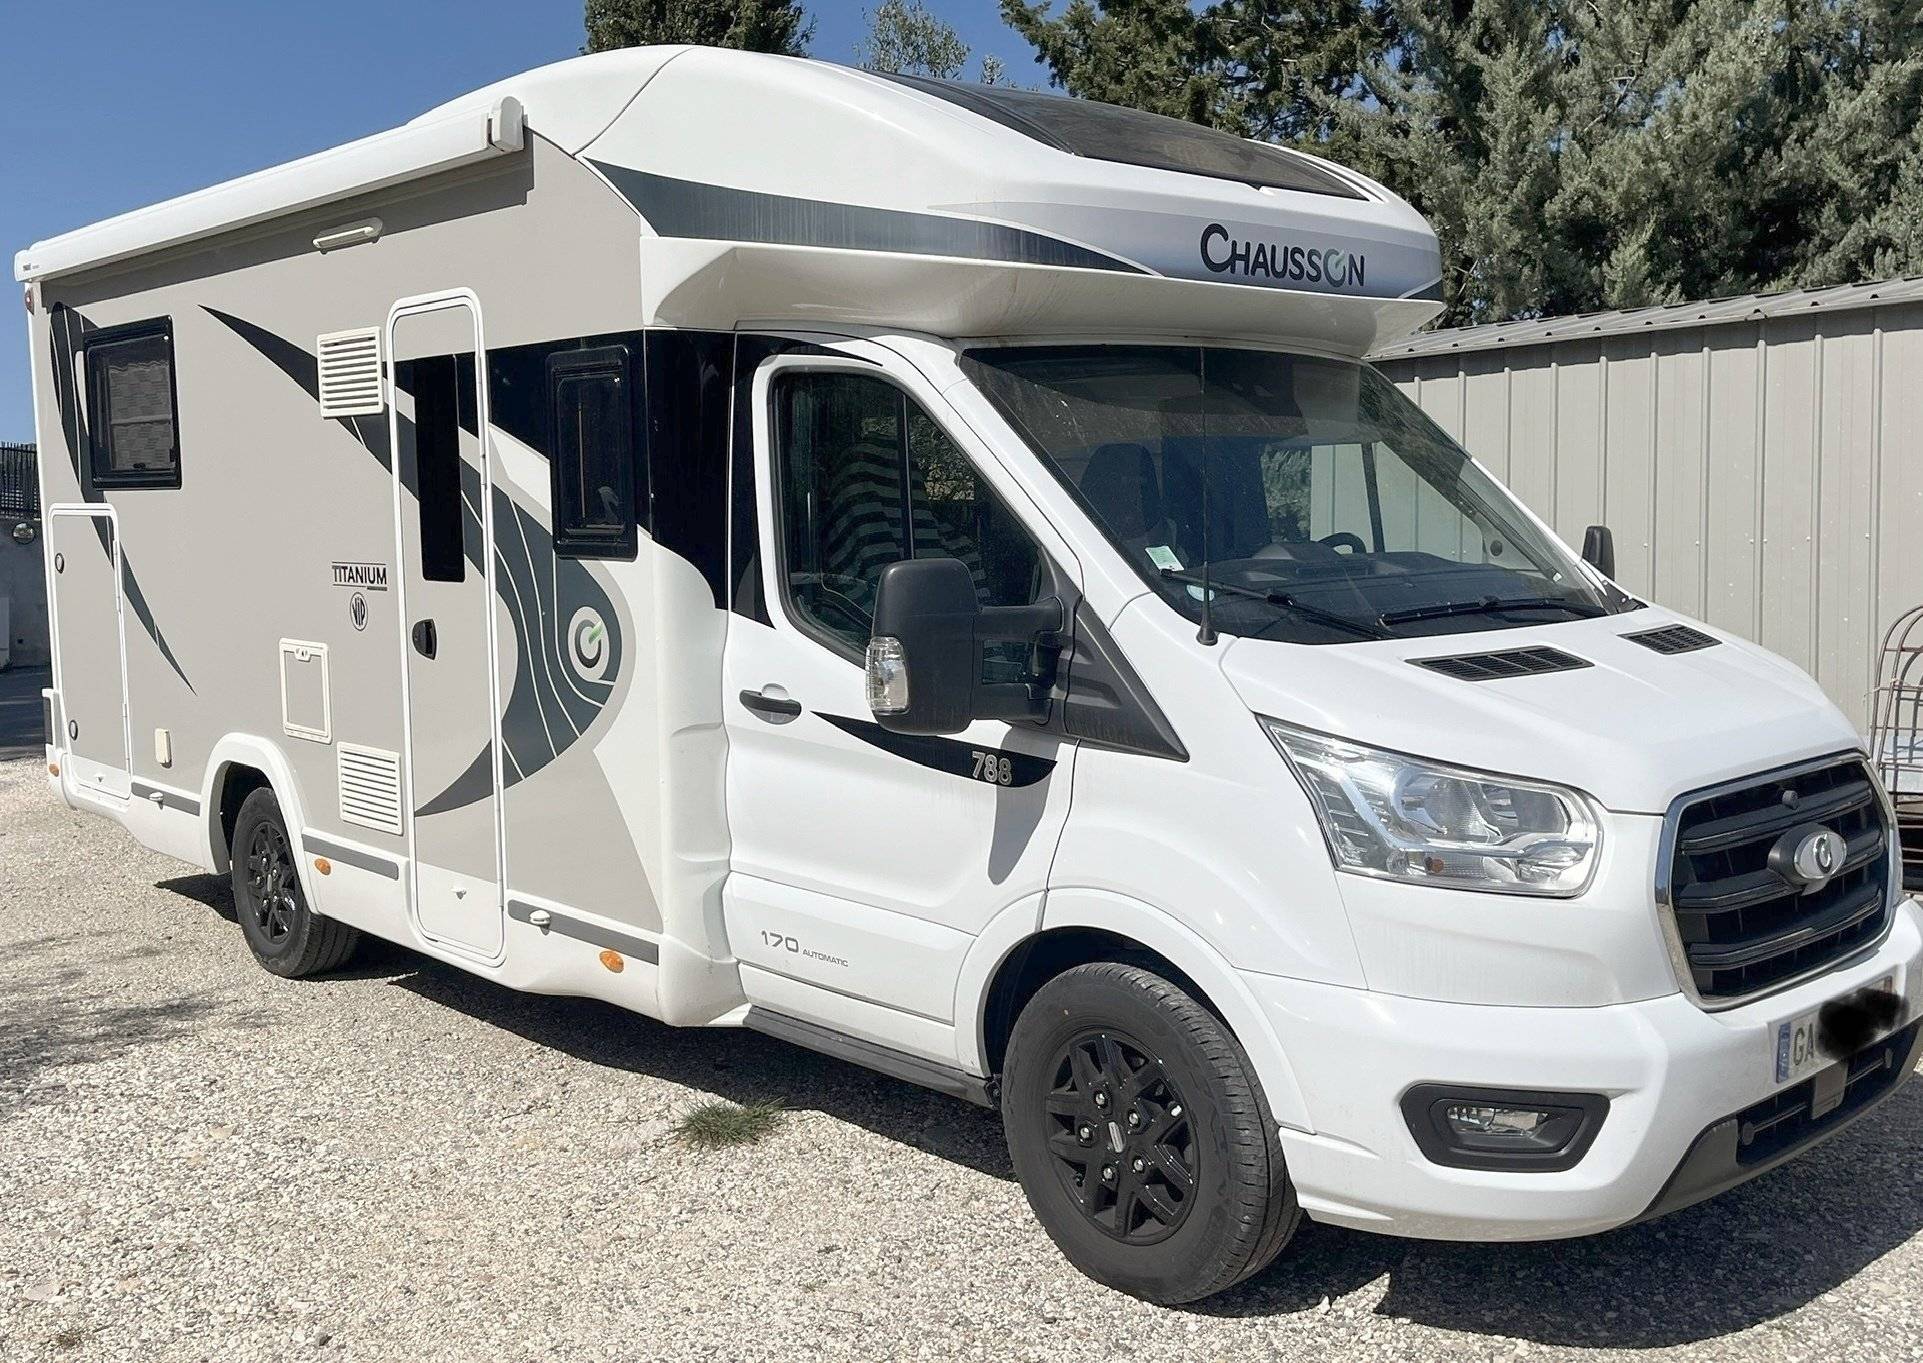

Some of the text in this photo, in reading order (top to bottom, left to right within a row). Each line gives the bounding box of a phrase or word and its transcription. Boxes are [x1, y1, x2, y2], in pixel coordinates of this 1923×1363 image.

[331, 565, 387, 585] TITANIUM
[971, 750, 1013, 786] 788
[761, 930, 849, 967] 170 AUTOMATIC
